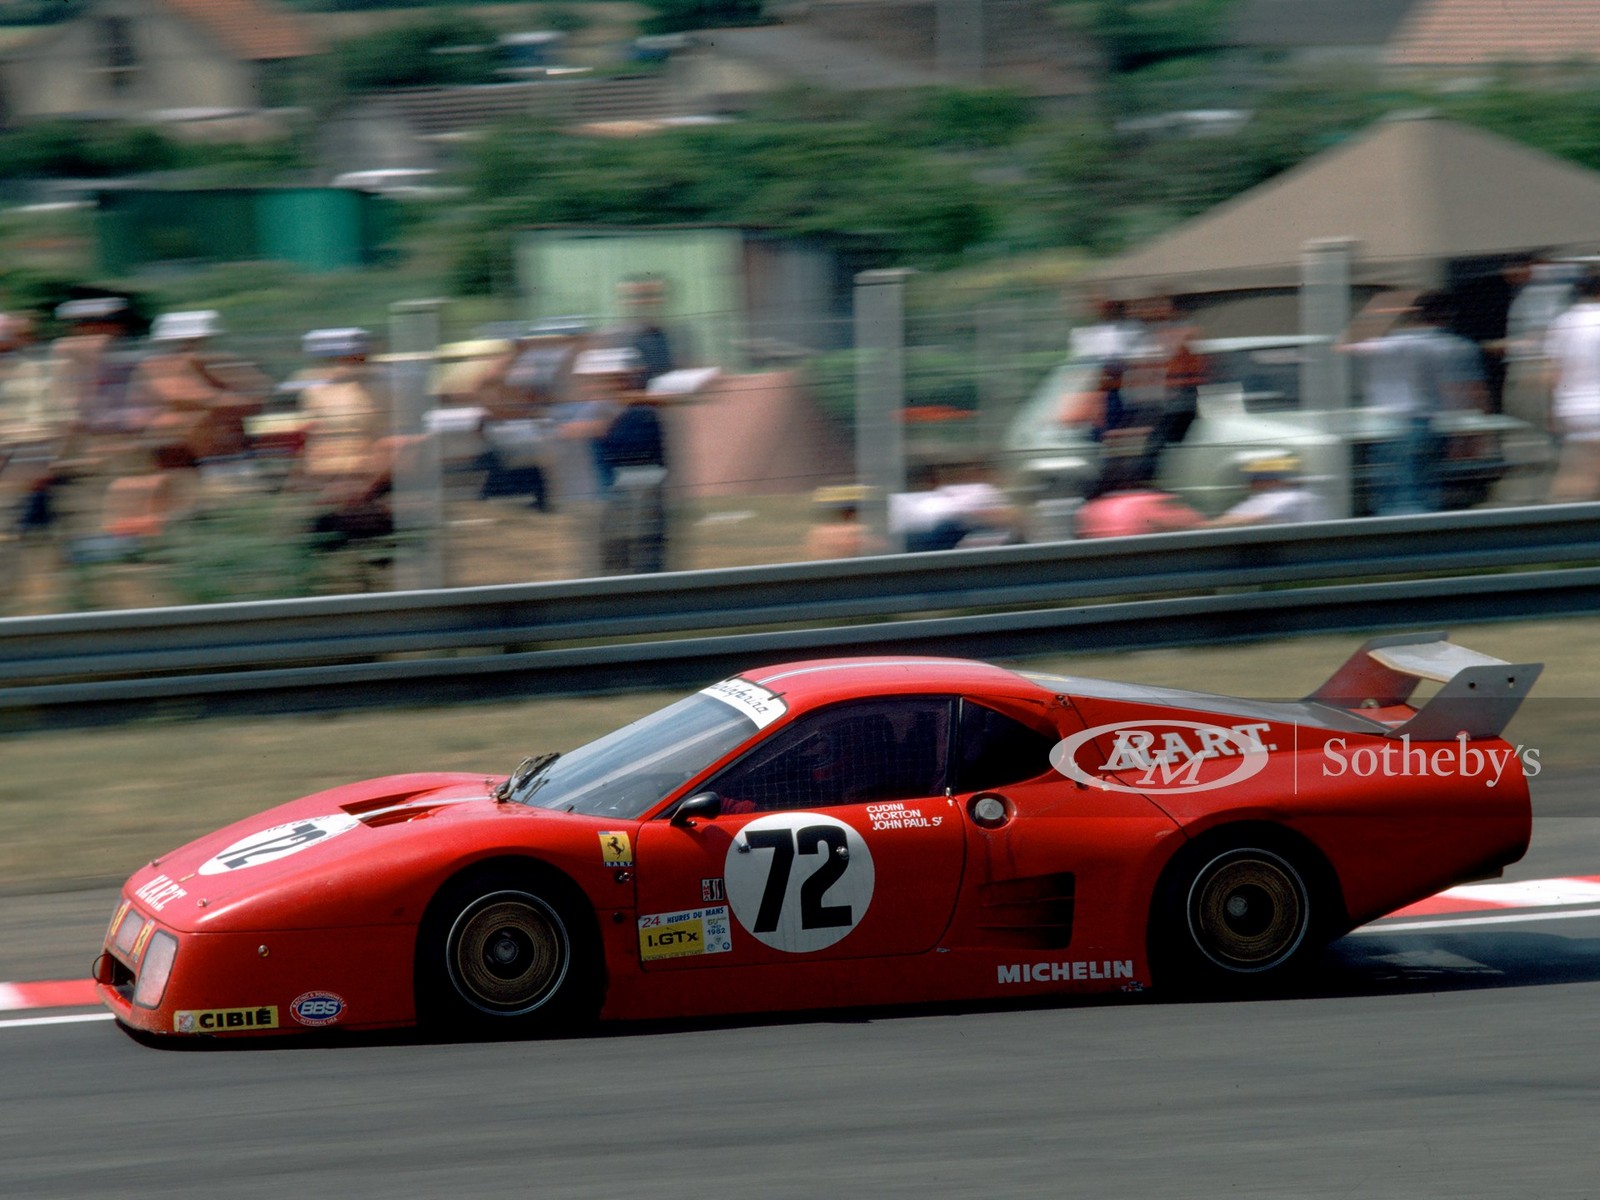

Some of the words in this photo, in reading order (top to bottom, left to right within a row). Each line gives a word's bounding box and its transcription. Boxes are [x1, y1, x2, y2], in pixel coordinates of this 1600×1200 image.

[866, 803, 905, 813] CUDINI
[869, 809, 921, 821] MORTON
[872, 820, 902, 831] JOHN
[903, 817, 931, 828] PAUL
[217, 822, 327, 869] 72
[744, 825, 852, 933] 72
[642, 915, 661, 928] 24
[666, 913, 690, 924] HEURES
[693, 911, 702, 919] DU
[705, 906, 724, 916] MANS
[707, 927, 726, 935] 1982
[997, 960, 1133, 984] MICHELIN
[300, 1001, 338, 1015] BBS
[199, 1008, 271, 1029] CIBIÉ
